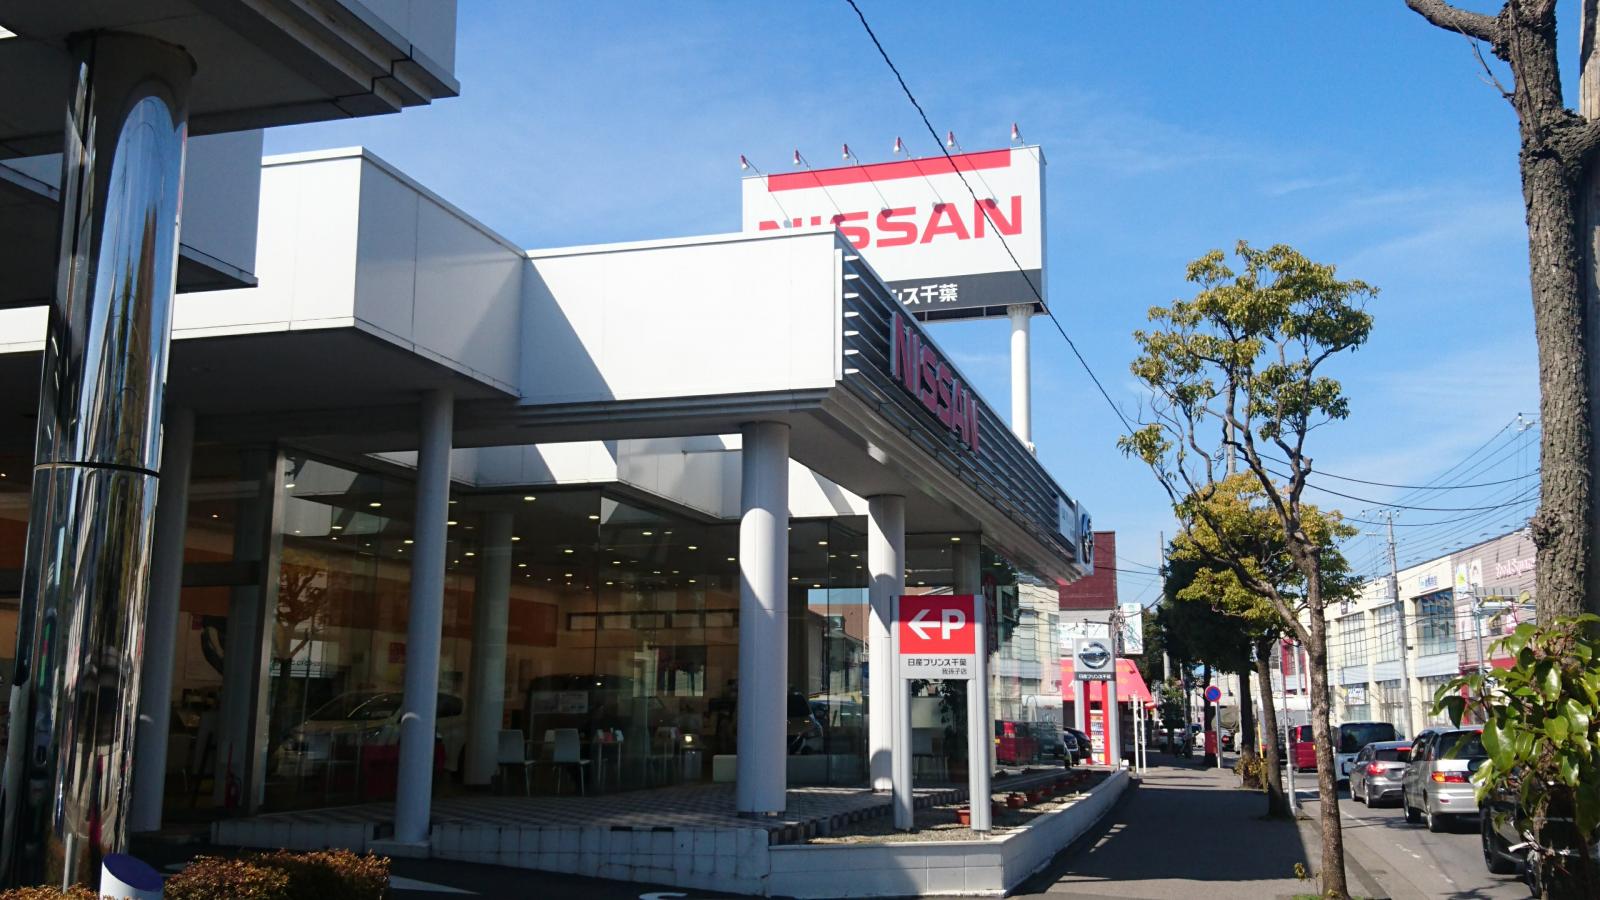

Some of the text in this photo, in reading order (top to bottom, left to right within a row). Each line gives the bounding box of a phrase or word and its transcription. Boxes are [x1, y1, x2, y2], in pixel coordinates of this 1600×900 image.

[759, 195, 1022, 249] SSAN
[890, 311, 979, 452] NISSAN
[942, 609, 966, 640] P
[908, 658, 967, 666] 日産プリンス千葉
